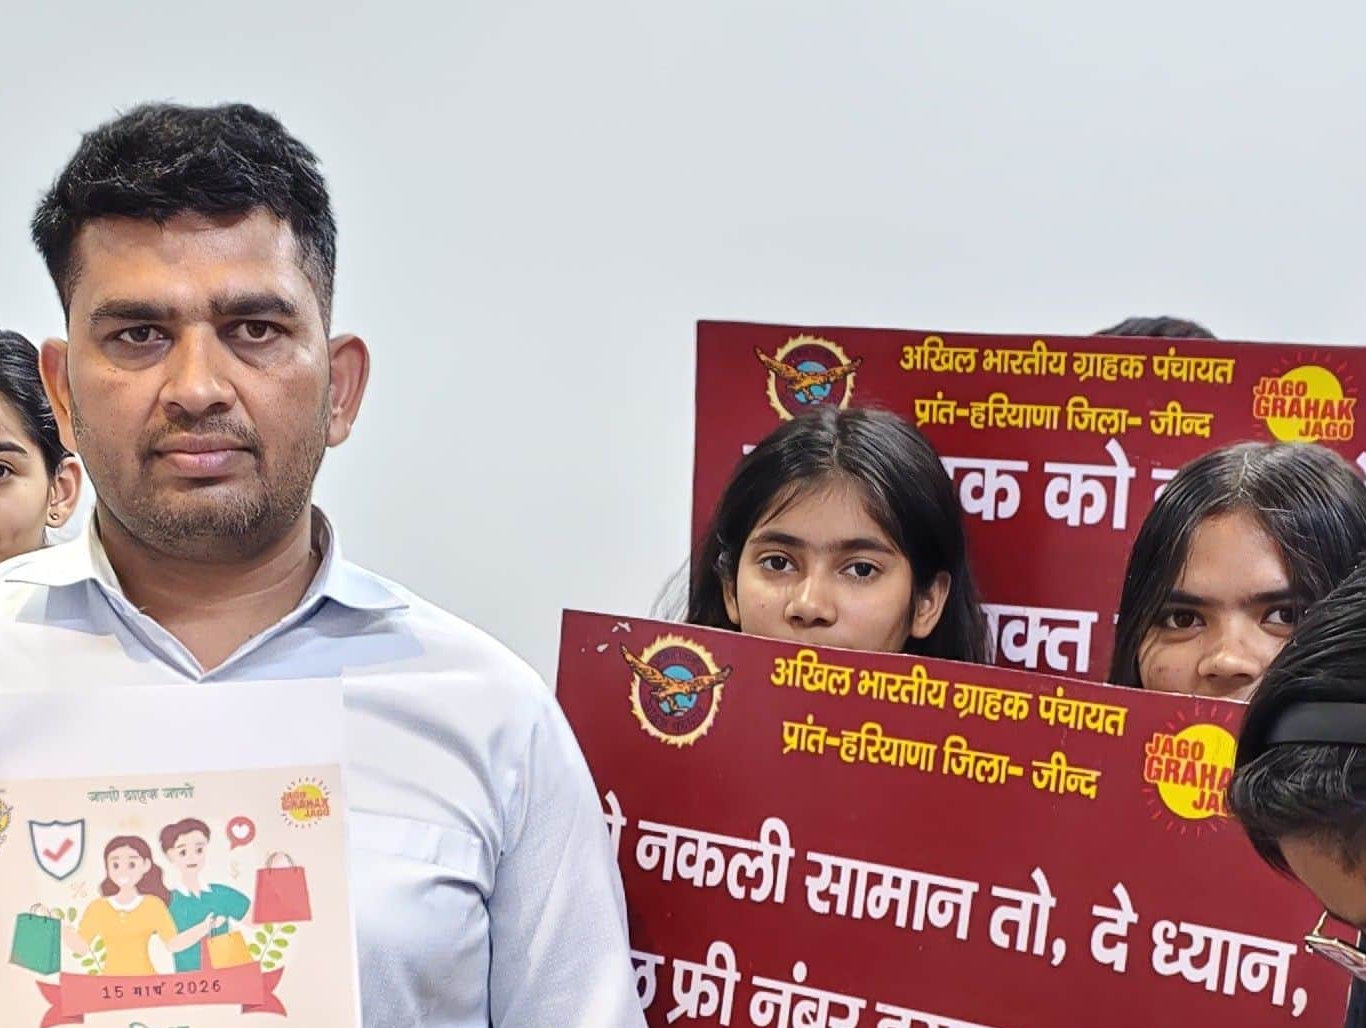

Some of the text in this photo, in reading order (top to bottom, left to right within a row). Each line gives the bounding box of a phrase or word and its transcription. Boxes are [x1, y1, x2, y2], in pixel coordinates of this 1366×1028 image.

[900, 335, 1236, 384] अखिल भारतीय ग्राहक पंचायत
[1254, 378, 1307, 398] JAGO
[1254, 396, 1354, 420] GRAHAK
[914, 391, 1214, 439] प्रांत-हरियाणा जिला- जीन्द
[1299, 419, 1353, 441] JAGO
[1044, 438, 1136, 530] को
[770, 648, 1129, 737] अखिल भारतीय ग्राहक पंचायत
[782, 714, 1100, 800] प्रांत-हरियाणा जिला- जीन्द
[1146, 733, 1205, 761] JAGO
[1146, 755, 1234, 790] GRAHA
[1192, 789, 1229, 815] JA
[636, 817, 796, 903] नकली
[804, 851, 980, 940] सामान
[989, 867, 1066, 966] तो,
[1090, 882, 1139, 973] दे
[1152, 919, 1314, 1017] ध्यान,
[102, 985, 124, 999] 15
[175, 979, 222, 996] 2026
[666, 941, 742, 1026] फ्री
